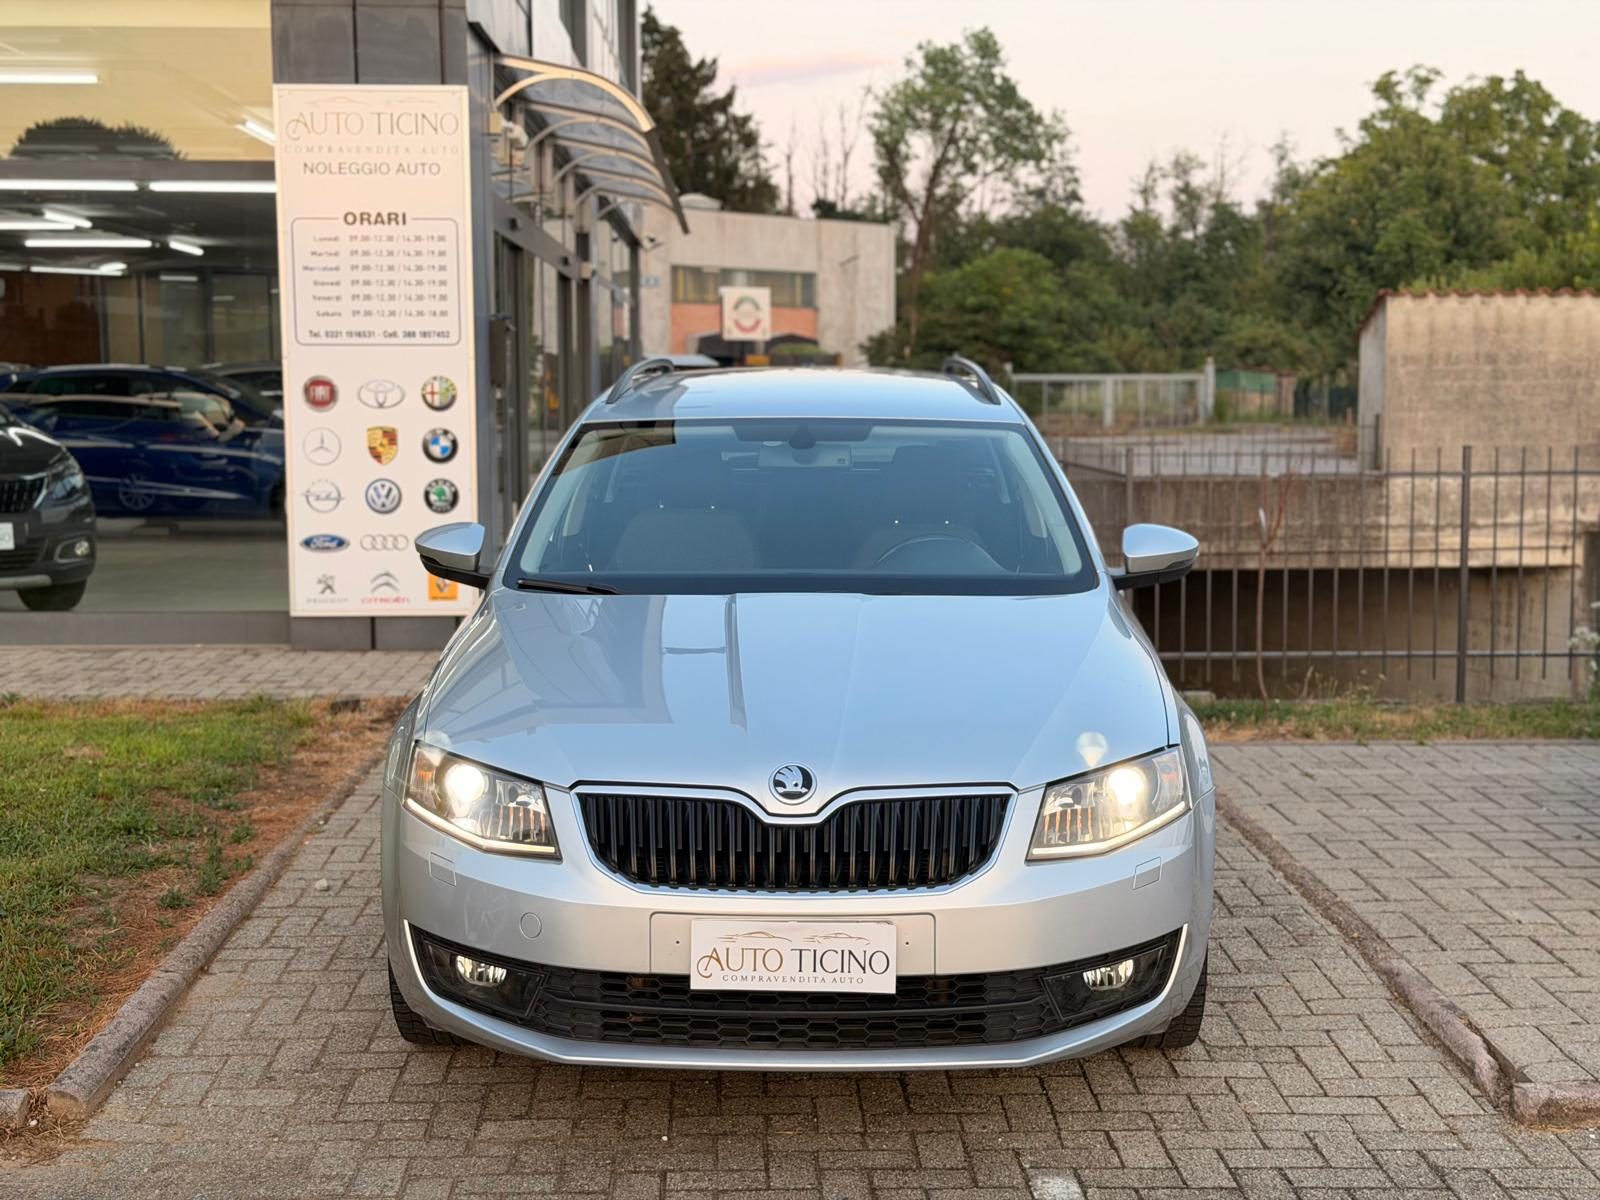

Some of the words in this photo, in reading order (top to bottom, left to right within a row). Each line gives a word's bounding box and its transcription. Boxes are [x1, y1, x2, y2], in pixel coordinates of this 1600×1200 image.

[286, 111, 364, 141] AUTO
[370, 112, 459, 136] TICINO
[284, 145, 411, 154] COMPRAVENDITA
[421, 146, 459, 155] AUTO
[303, 162, 391, 176] NOLEGGIO
[395, 162, 441, 176] AUTO
[343, 211, 407, 226] ORARI
[696, 947, 784, 979] AUTO
[790, 948, 890, 975] TICINO
[722, 974, 826, 983] COMPRAVENDITA
